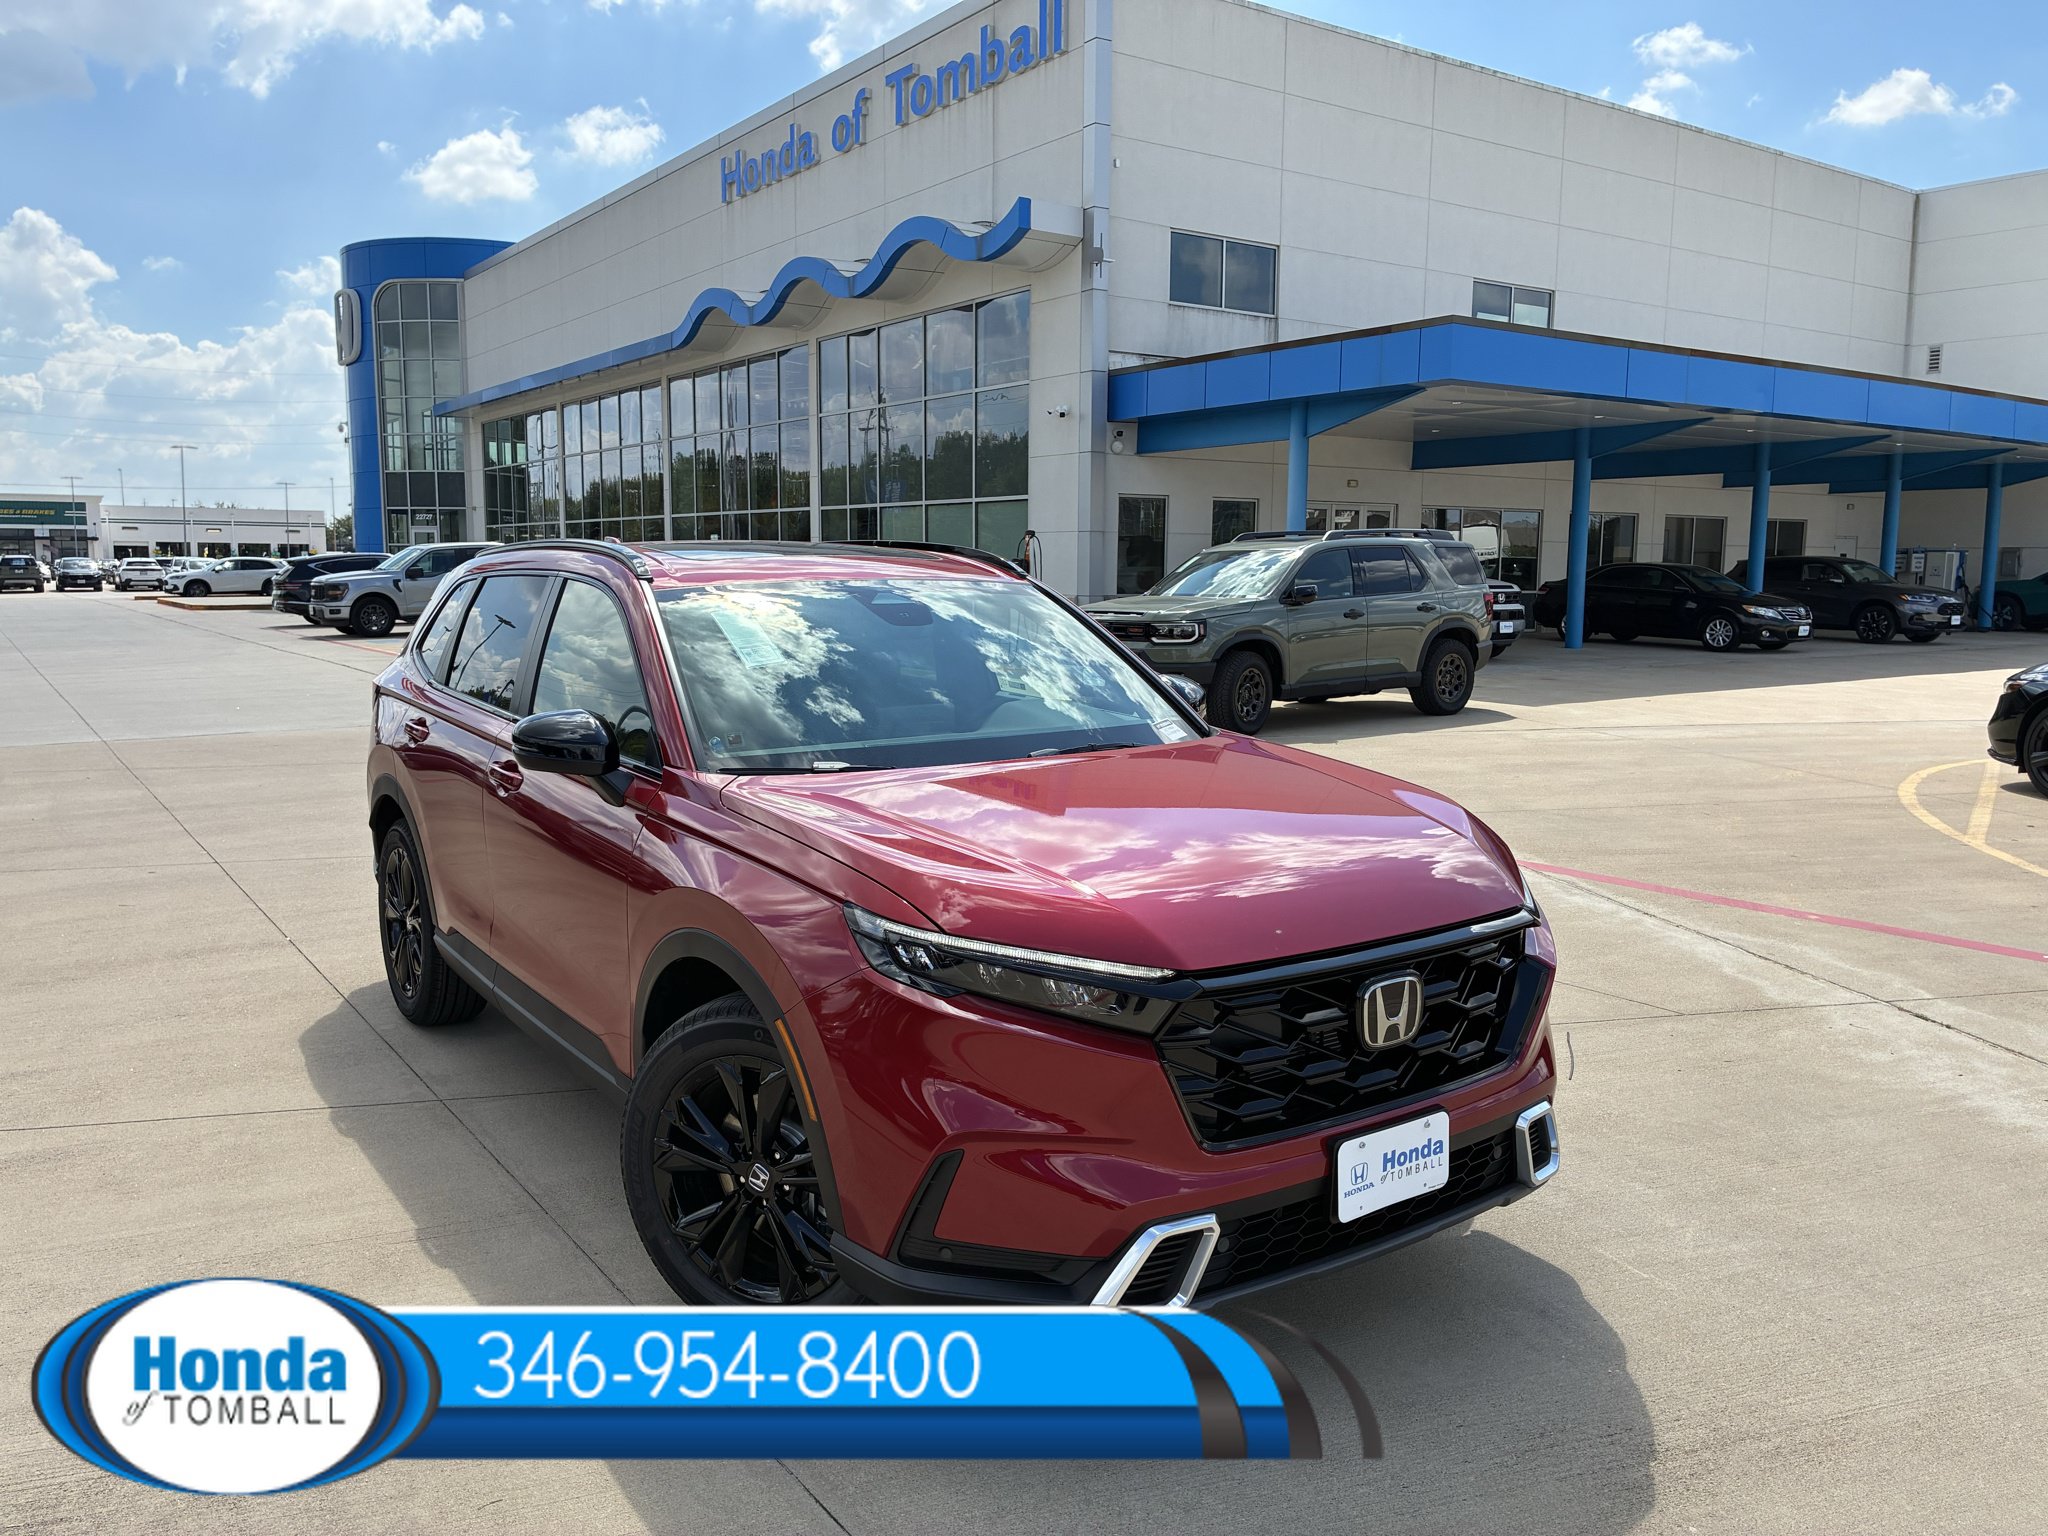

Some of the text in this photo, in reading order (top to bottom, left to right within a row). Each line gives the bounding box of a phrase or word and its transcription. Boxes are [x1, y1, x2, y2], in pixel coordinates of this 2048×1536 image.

[720, 0, 1069, 203] Honda of Tomball
[1380, 1156, 1443, 1184] of TOMBALL
[1382, 1137, 1444, 1172] Honda
[1343, 1181, 1375, 1199] HONDA
